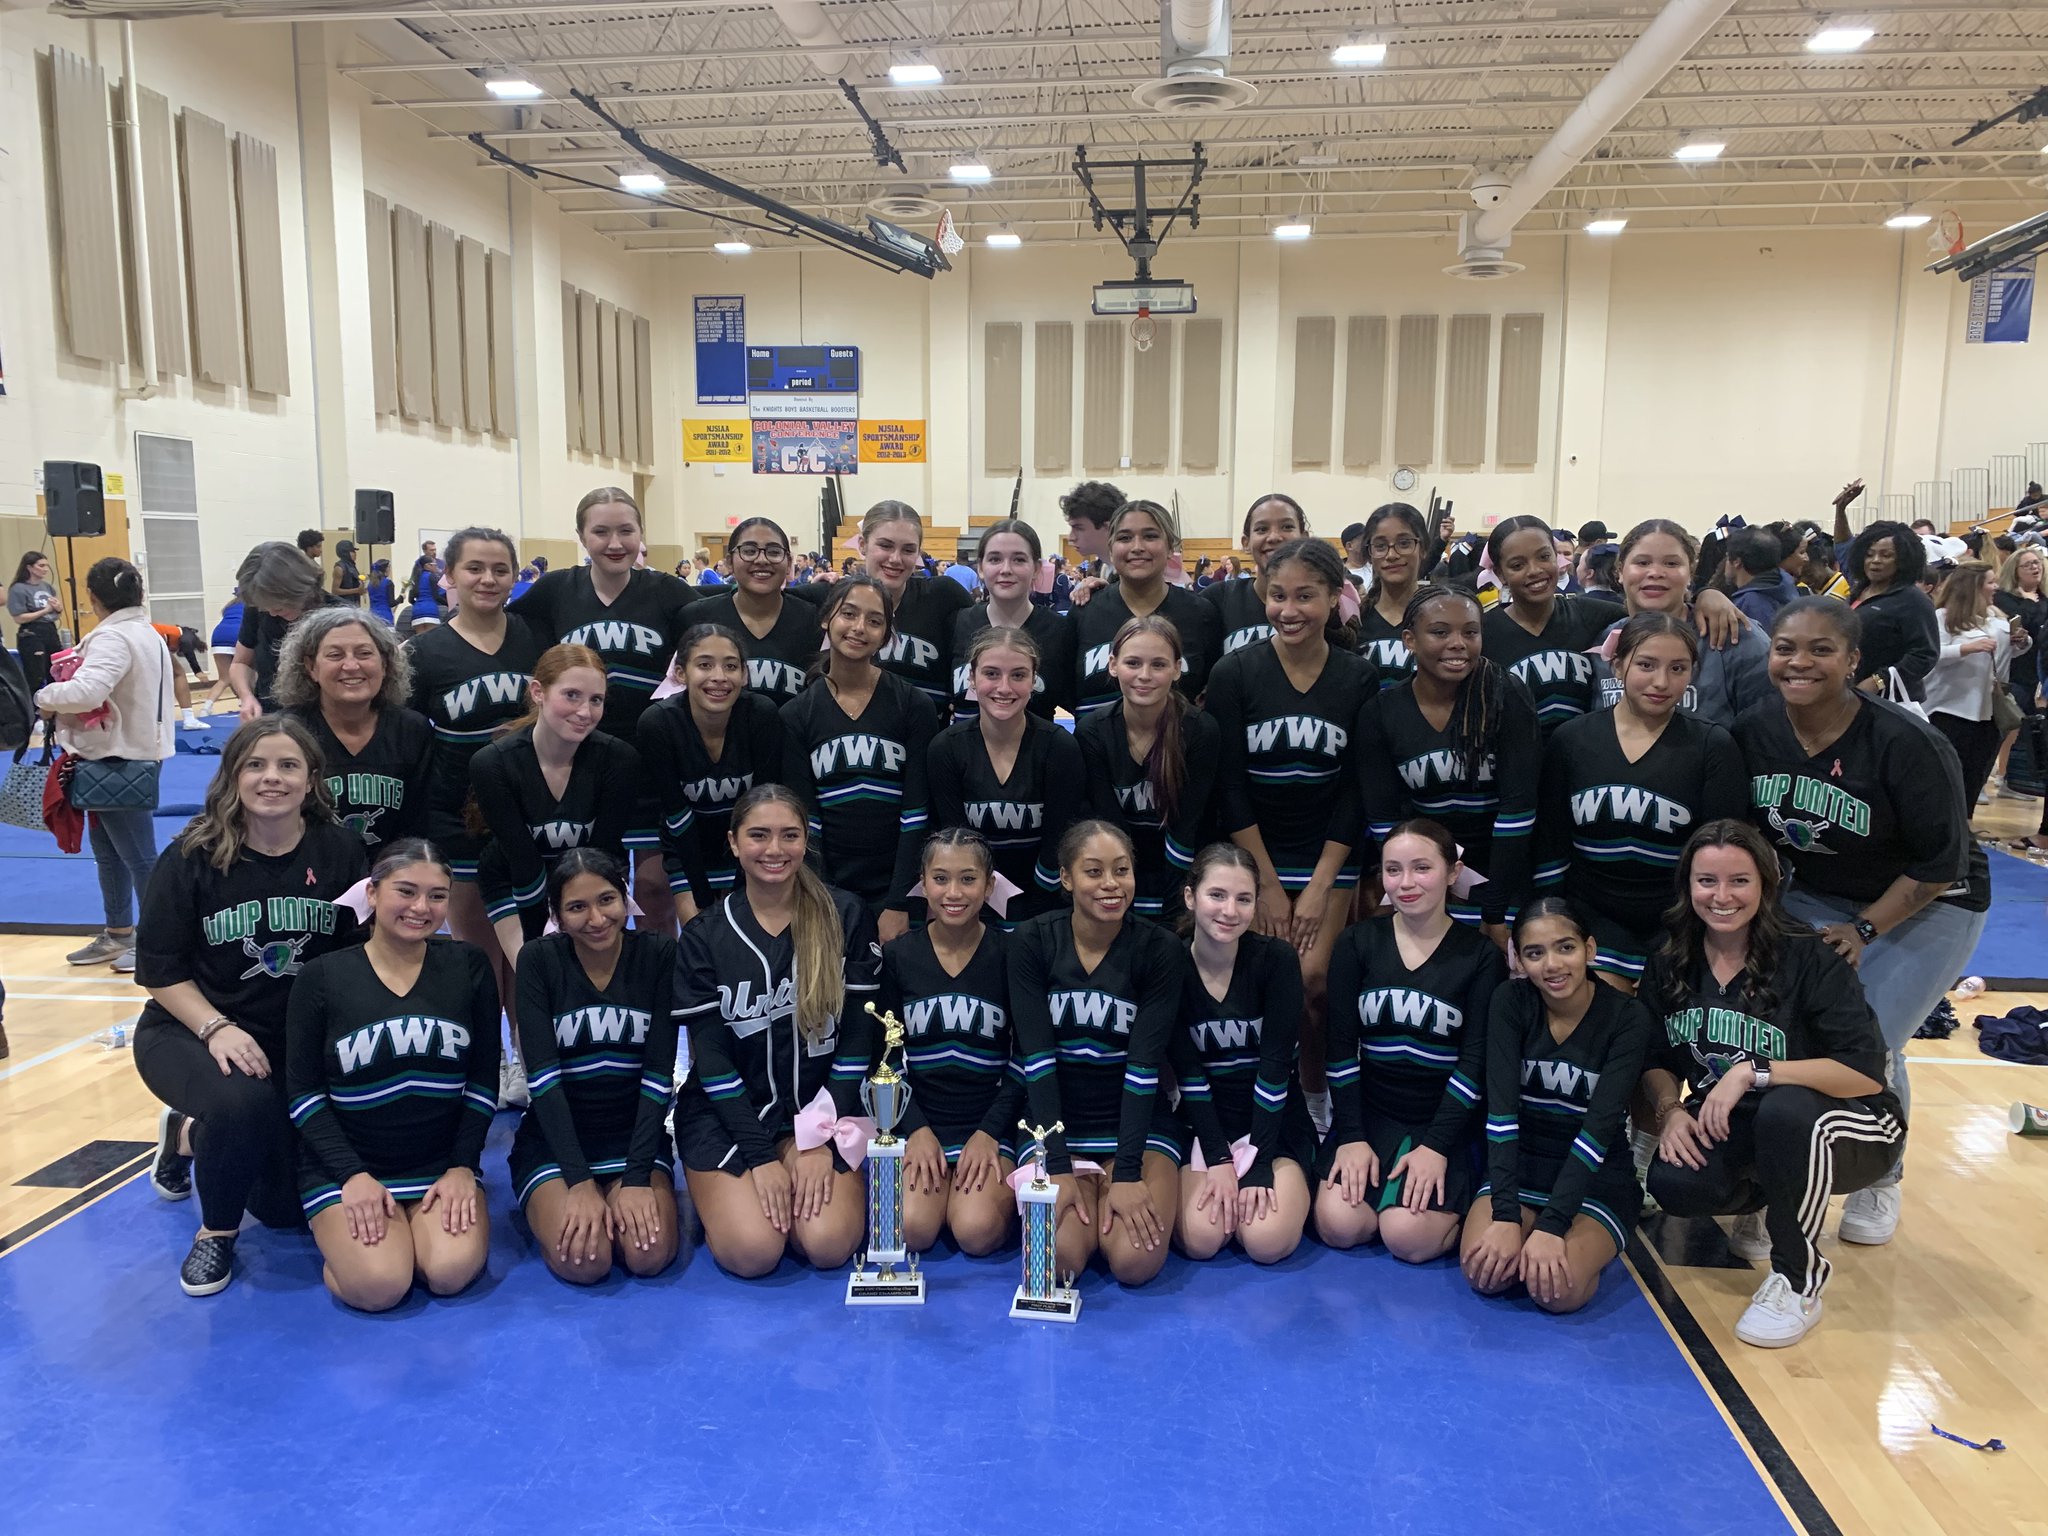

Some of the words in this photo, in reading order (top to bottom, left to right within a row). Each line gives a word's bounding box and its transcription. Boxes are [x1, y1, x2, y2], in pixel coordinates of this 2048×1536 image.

[751, 348, 770, 358] Home
[830, 348, 854, 358] Guests
[791, 377, 812, 387] period
[753, 420, 810, 432] COLONIAL
[812, 420, 856, 433] VALLEY
[799, 405, 829, 413] BASKETBALL
[692, 433, 744, 441] SPORTSMANSHIP
[706, 425, 730, 433] NJSIAA
[770, 430, 840, 439] CONFERENCE
[862, 433, 920, 441] SPORTSMANSHIP
[878, 424, 905, 433] NJSIAA
[879, 442, 904, 450] AWARD
[560, 621, 664, 655] WWP
[443, 672, 536, 721] WW
[1247, 716, 1348, 757] WWP
[810, 735, 907, 780] WWP
[348, 773, 404, 810] UNITE
[1793, 775, 1871, 837] UNITED
[1571, 786, 1692, 834] WWP
[202, 899, 262, 946] WWP
[903, 995, 1007, 1039] WWP
[1048, 991, 1138, 1034] WWP
[1358, 988, 1463, 1037] WWP
[336, 1016, 471, 1075] WWP
[1706, 1007, 1787, 1061] UNITED
